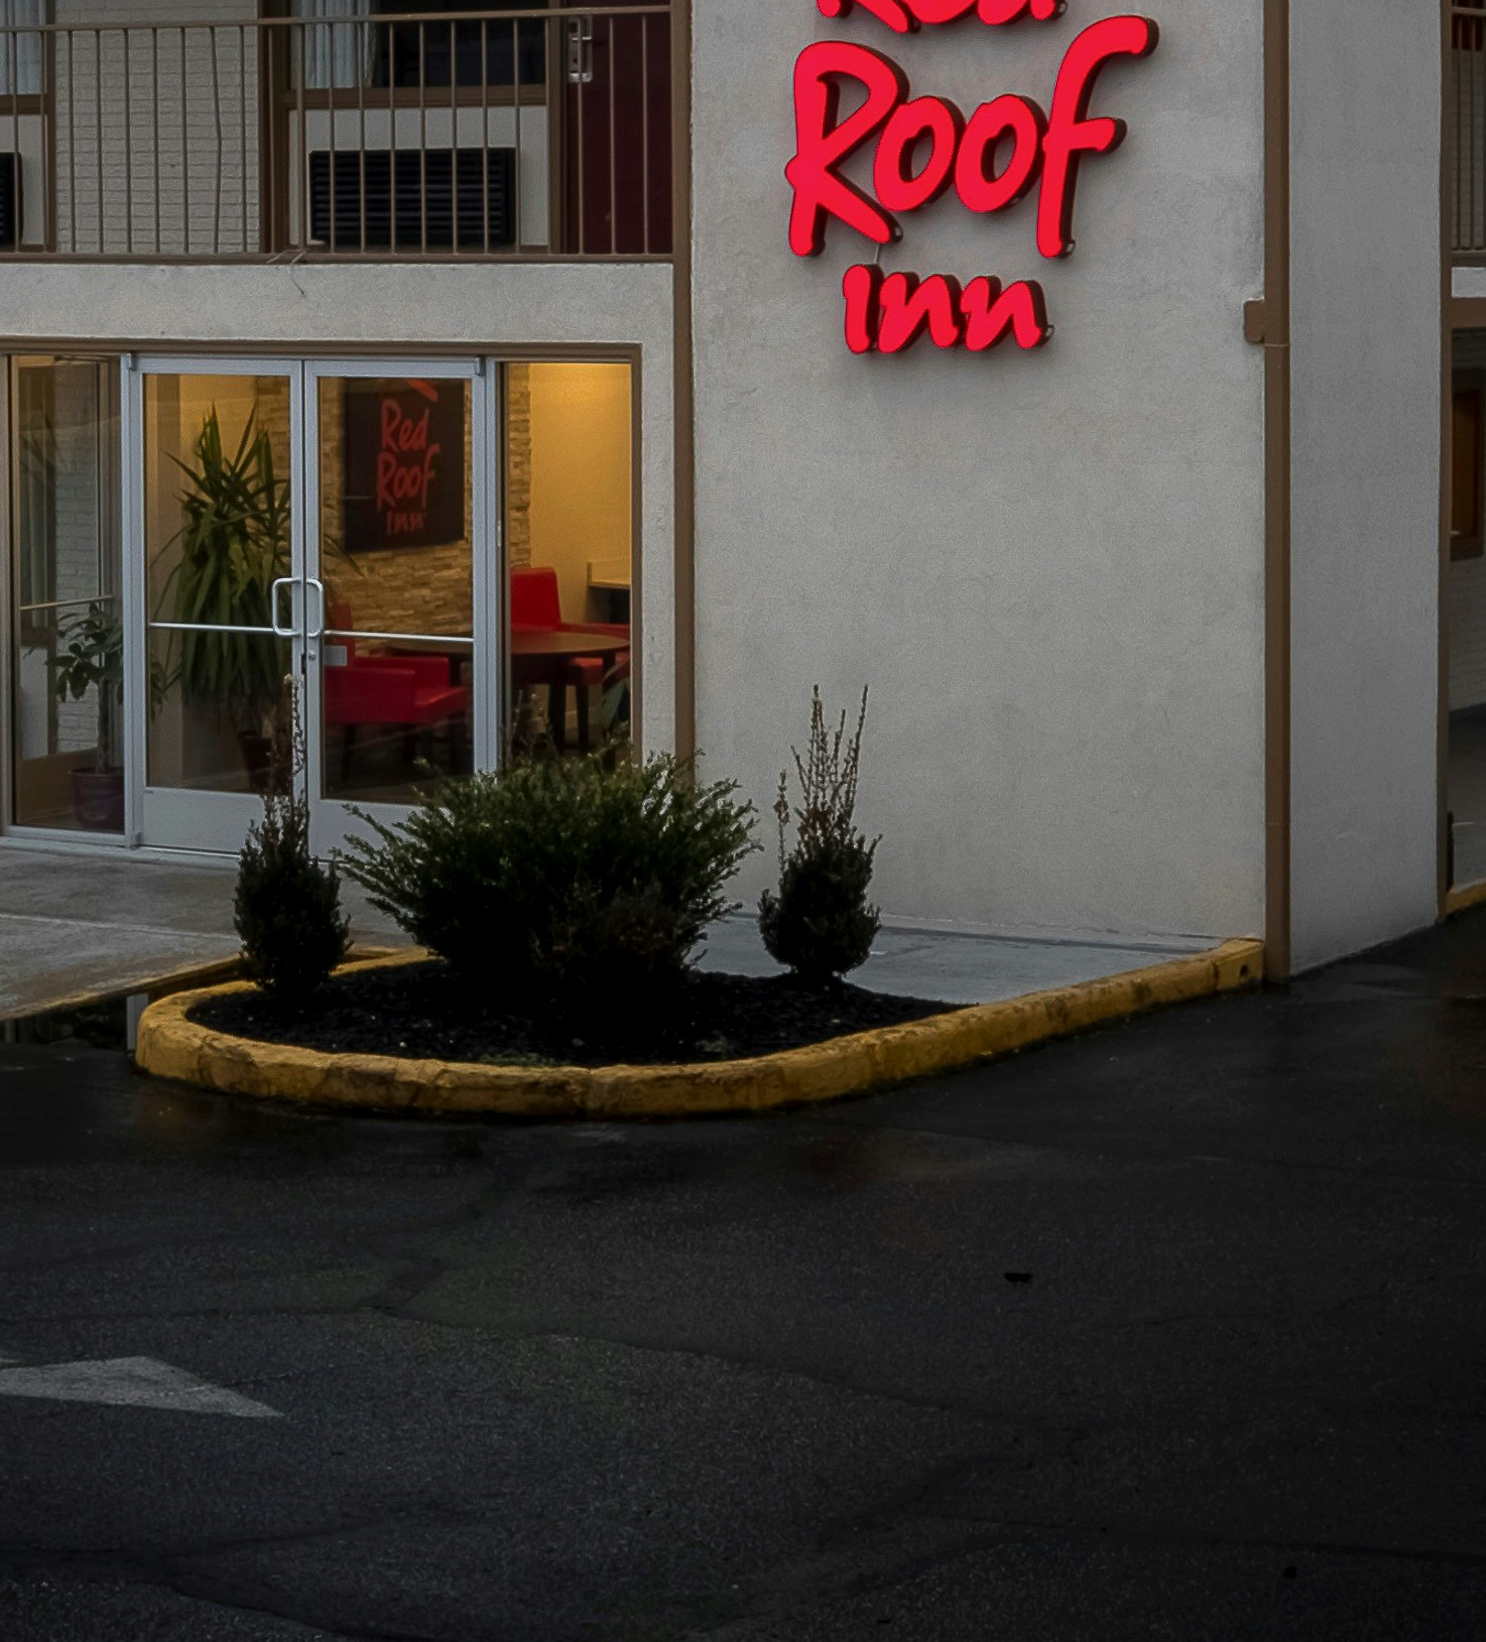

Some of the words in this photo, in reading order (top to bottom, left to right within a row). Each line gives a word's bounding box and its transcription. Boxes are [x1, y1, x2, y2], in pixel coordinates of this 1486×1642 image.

[784, 14, 1157, 258] Roof
[381, 398, 430, 453] Red
[375, 443, 441, 512] Roof
